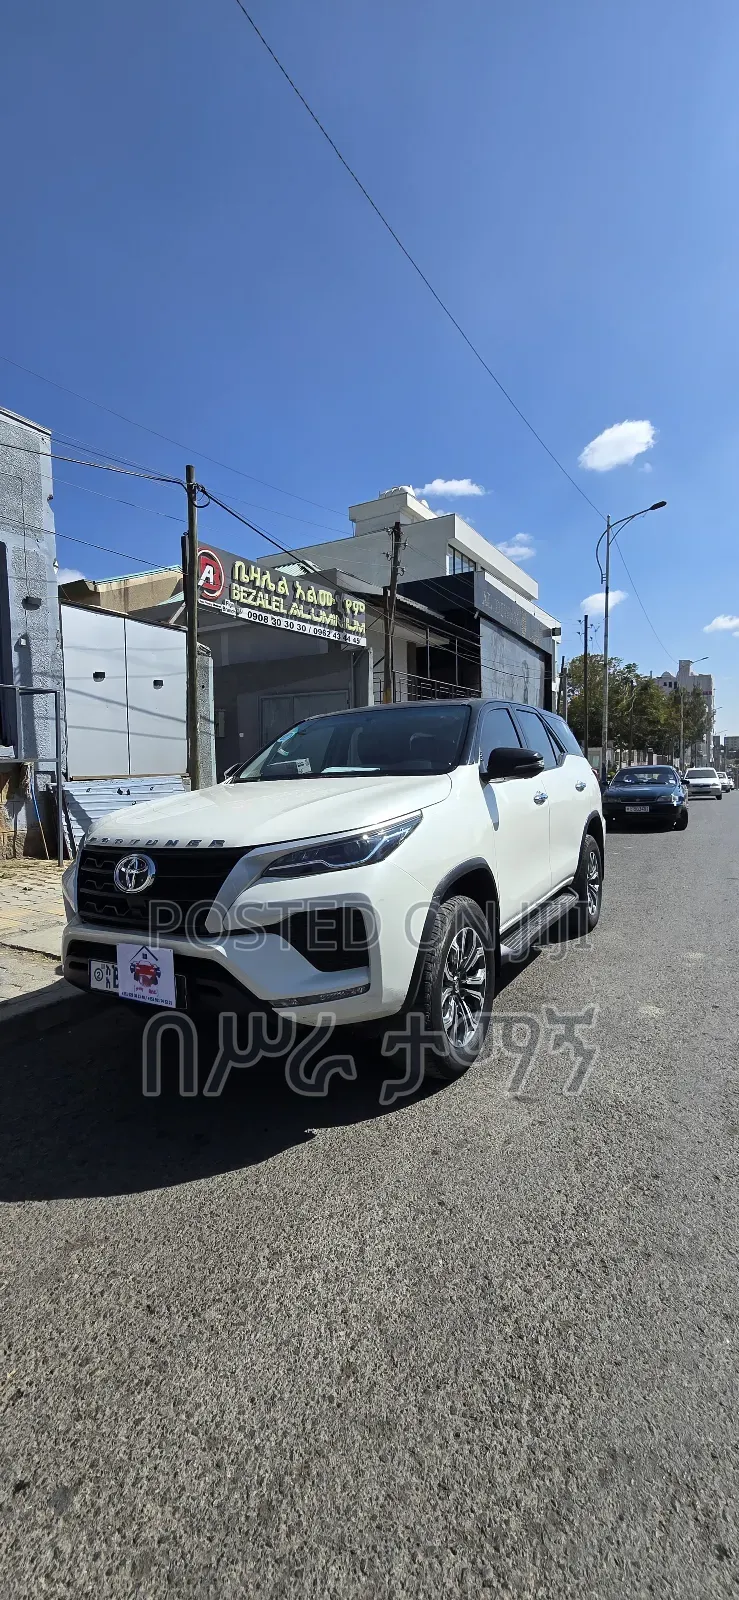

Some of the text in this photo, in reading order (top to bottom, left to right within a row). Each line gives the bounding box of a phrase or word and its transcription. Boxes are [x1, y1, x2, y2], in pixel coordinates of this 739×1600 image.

[231, 583, 287, 614] BEZALEL
[247, 611, 269, 624] 0908
[271, 617, 282, 626] 30
[284, 620, 294, 630] 30
[296, 623, 306, 632] 30
[313, 627, 331, 638] 0962
[332, 632, 341, 640] 43
